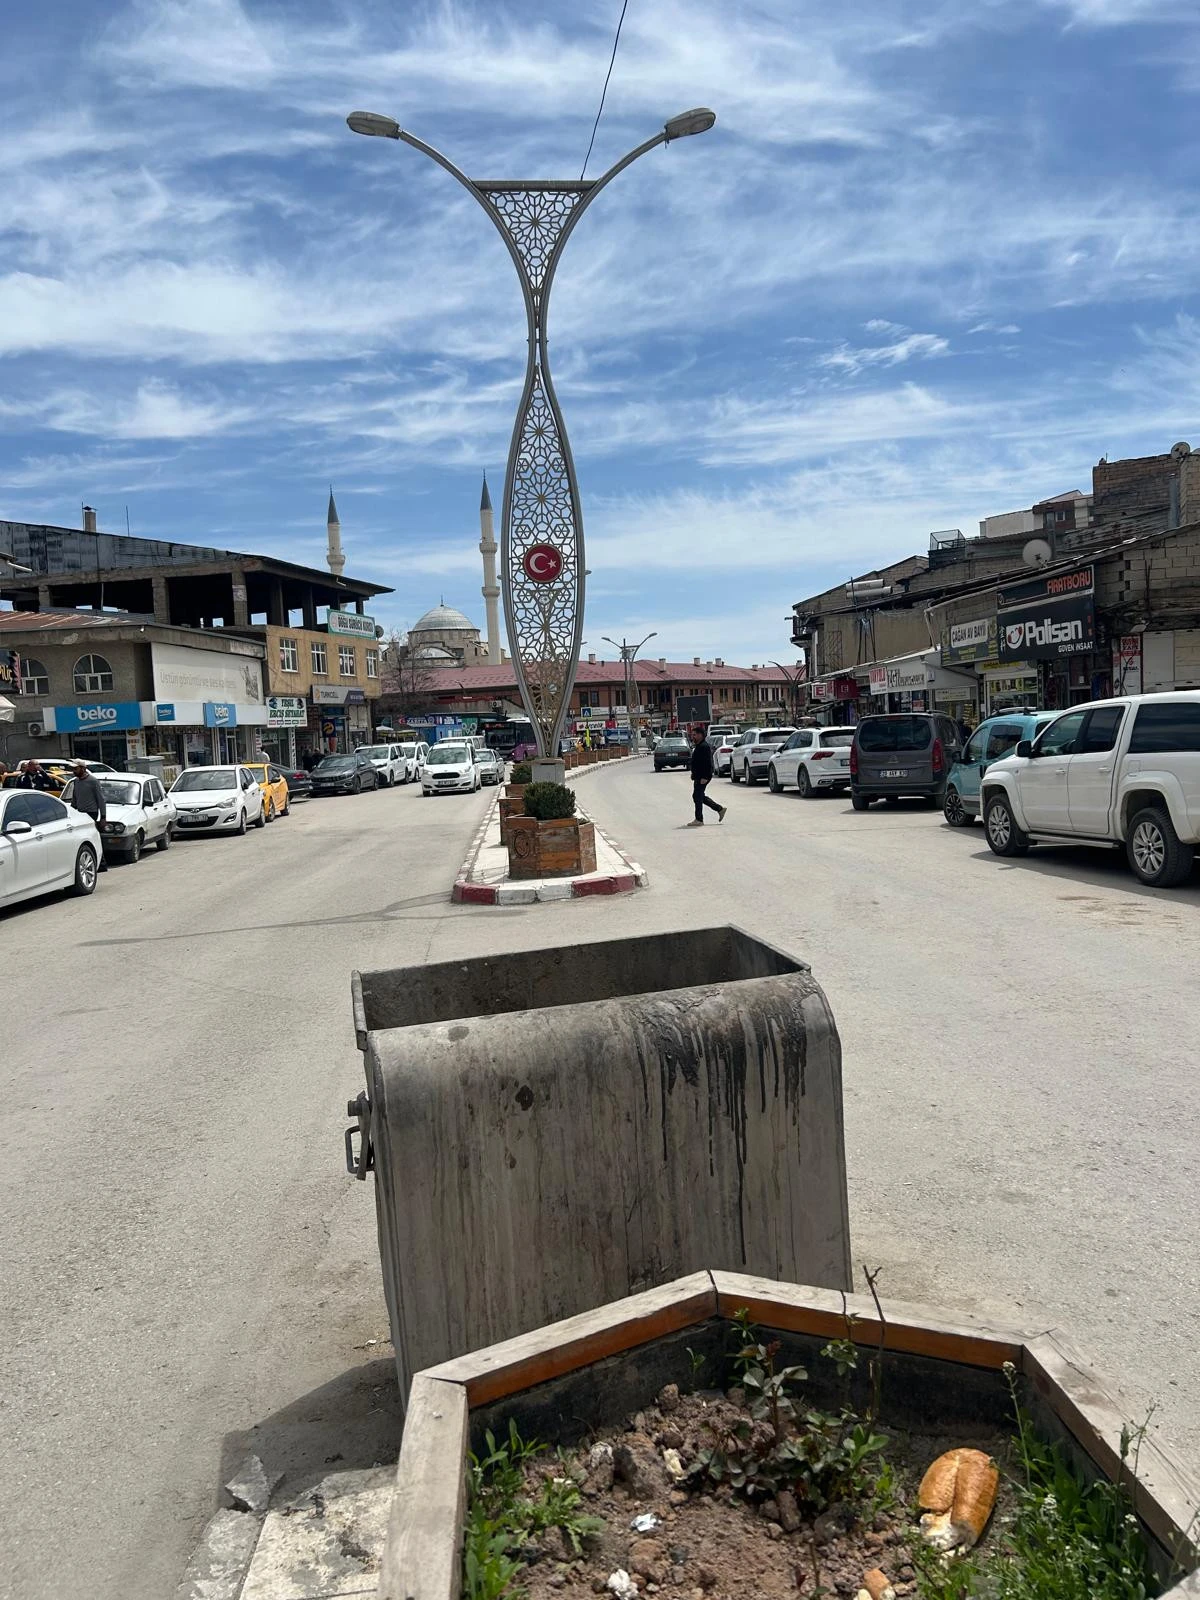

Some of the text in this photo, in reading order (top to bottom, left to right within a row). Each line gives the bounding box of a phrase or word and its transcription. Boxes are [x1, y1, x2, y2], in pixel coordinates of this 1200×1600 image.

[1047, 570, 1091, 595] FIRATBORU
[1024, 618, 1083, 647] Polisan
[816, 686, 824, 696] E
[77, 706, 117, 720] beko
[214, 705, 229, 718] beko
